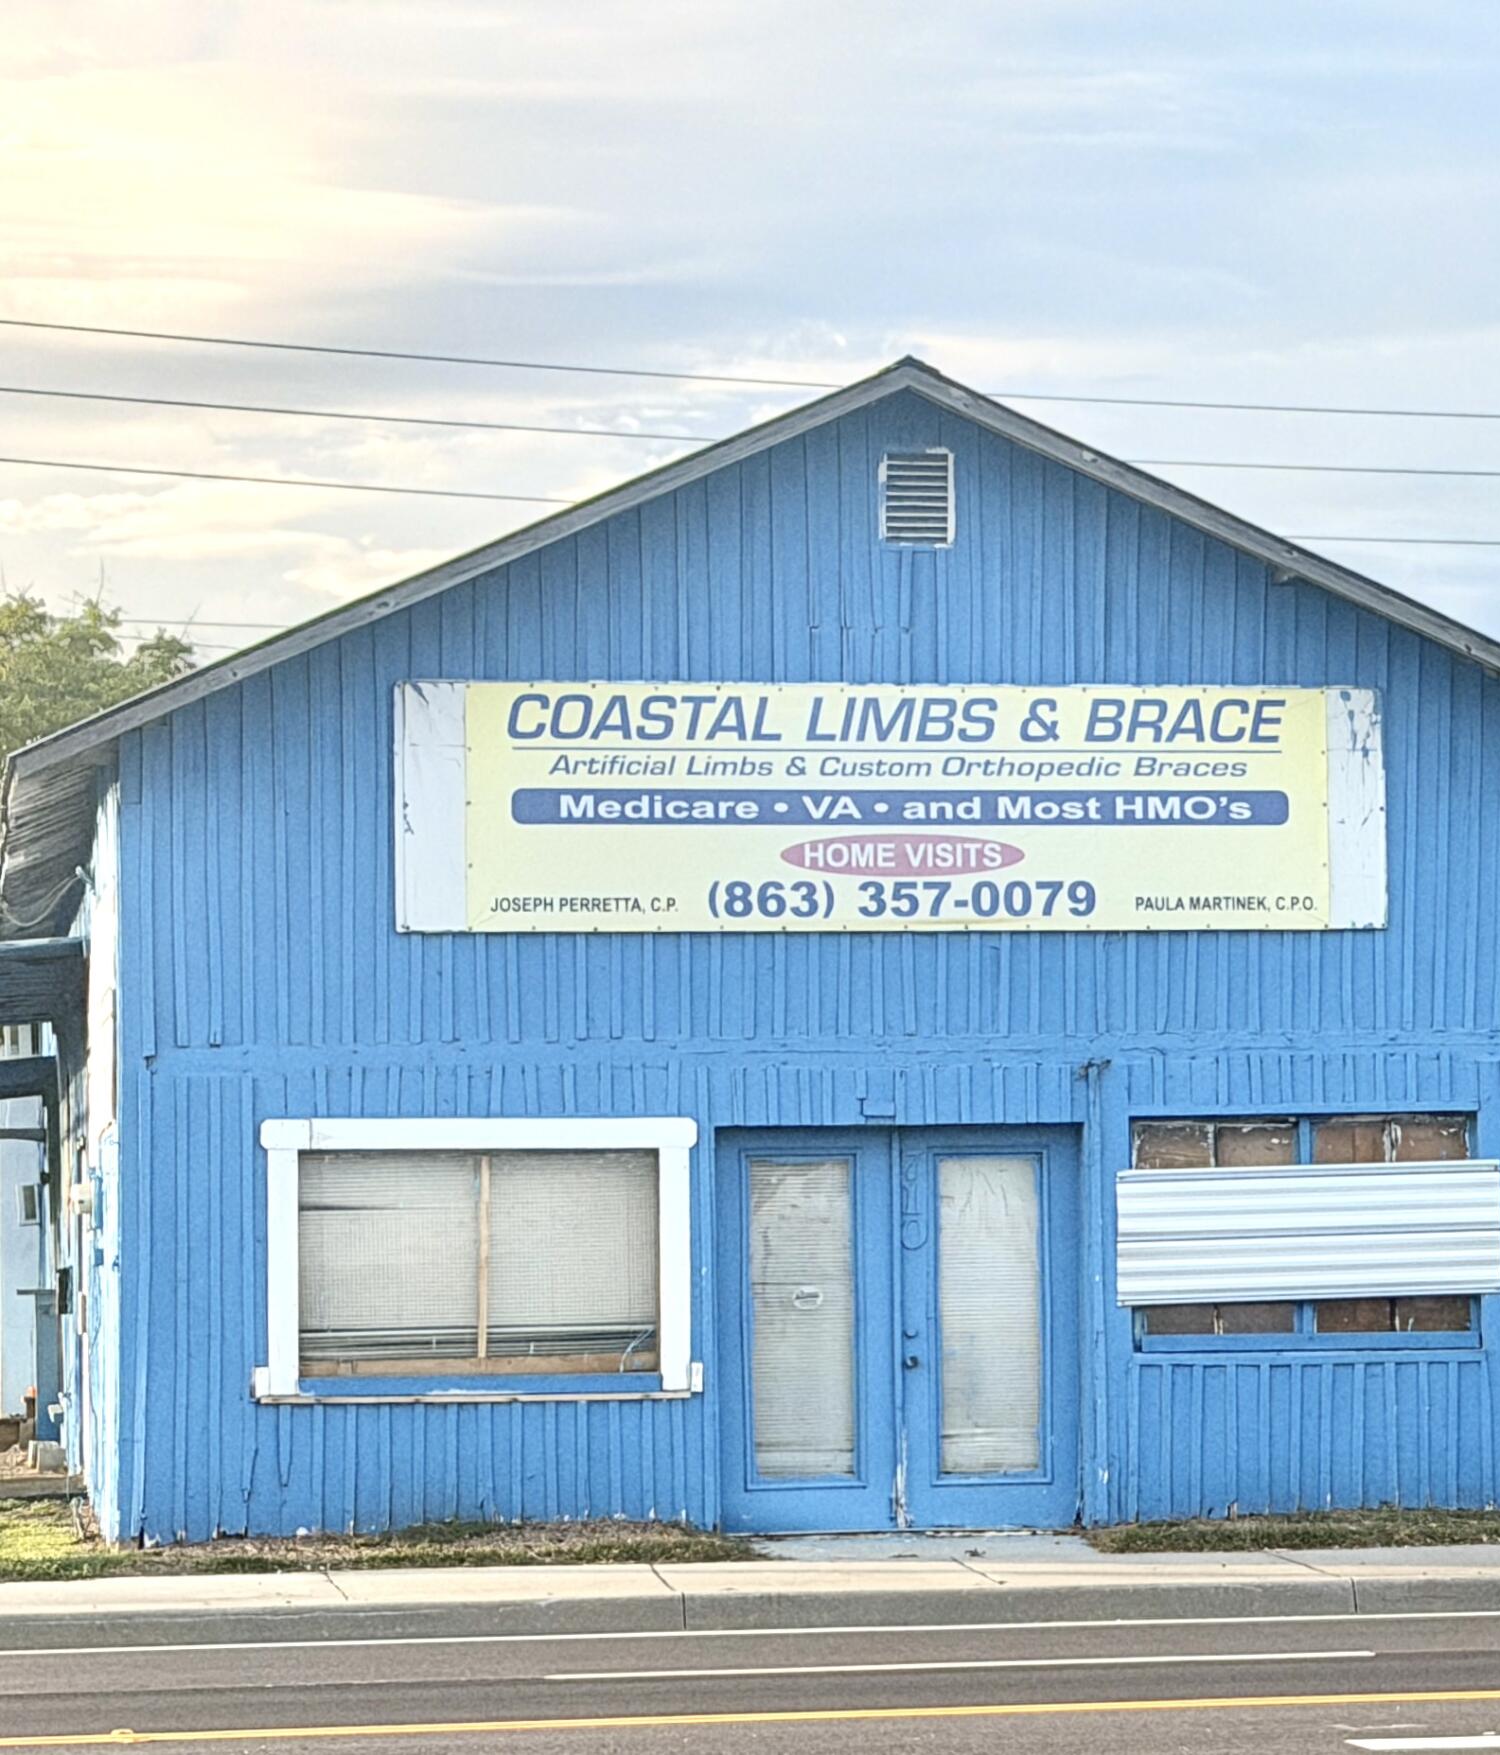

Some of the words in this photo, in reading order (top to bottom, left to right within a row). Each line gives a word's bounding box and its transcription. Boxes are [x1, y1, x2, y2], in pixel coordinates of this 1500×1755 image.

[508, 693, 782, 741] COASTAL
[806, 697, 998, 742] LIMBS
[1020, 698, 1059, 742] &
[1085, 698, 1287, 743] BRACE
[549, 755, 676, 776] Artificial
[686, 756, 773, 776] Limbs
[786, 756, 806, 776] &
[820, 757, 931, 776] Custom
[942, 756, 1121, 782] Orthopedic
[1133, 757, 1248, 777] Braces
[560, 795, 759, 818] Medicare
[802, 796, 861, 819] VA
[903, 797, 981, 819] and
[998, 796, 1101, 819] Most
[1116, 797, 1251, 819] HMO's
[803, 843, 896, 868] HOME
[904, 844, 1003, 868] VISITS
[491, 897, 553, 912] JOSEPH
[560, 898, 646, 915] PERRETTA,
[651, 897, 679, 912] C.P.
[709, 881, 834, 918] (863)
[859, 881, 1095, 917] 357-0079
[1136, 897, 1185, 911] PAULA
[1190, 896, 1271, 913] MARTINEK,
[1276, 896, 1318, 911] C.P.O.
